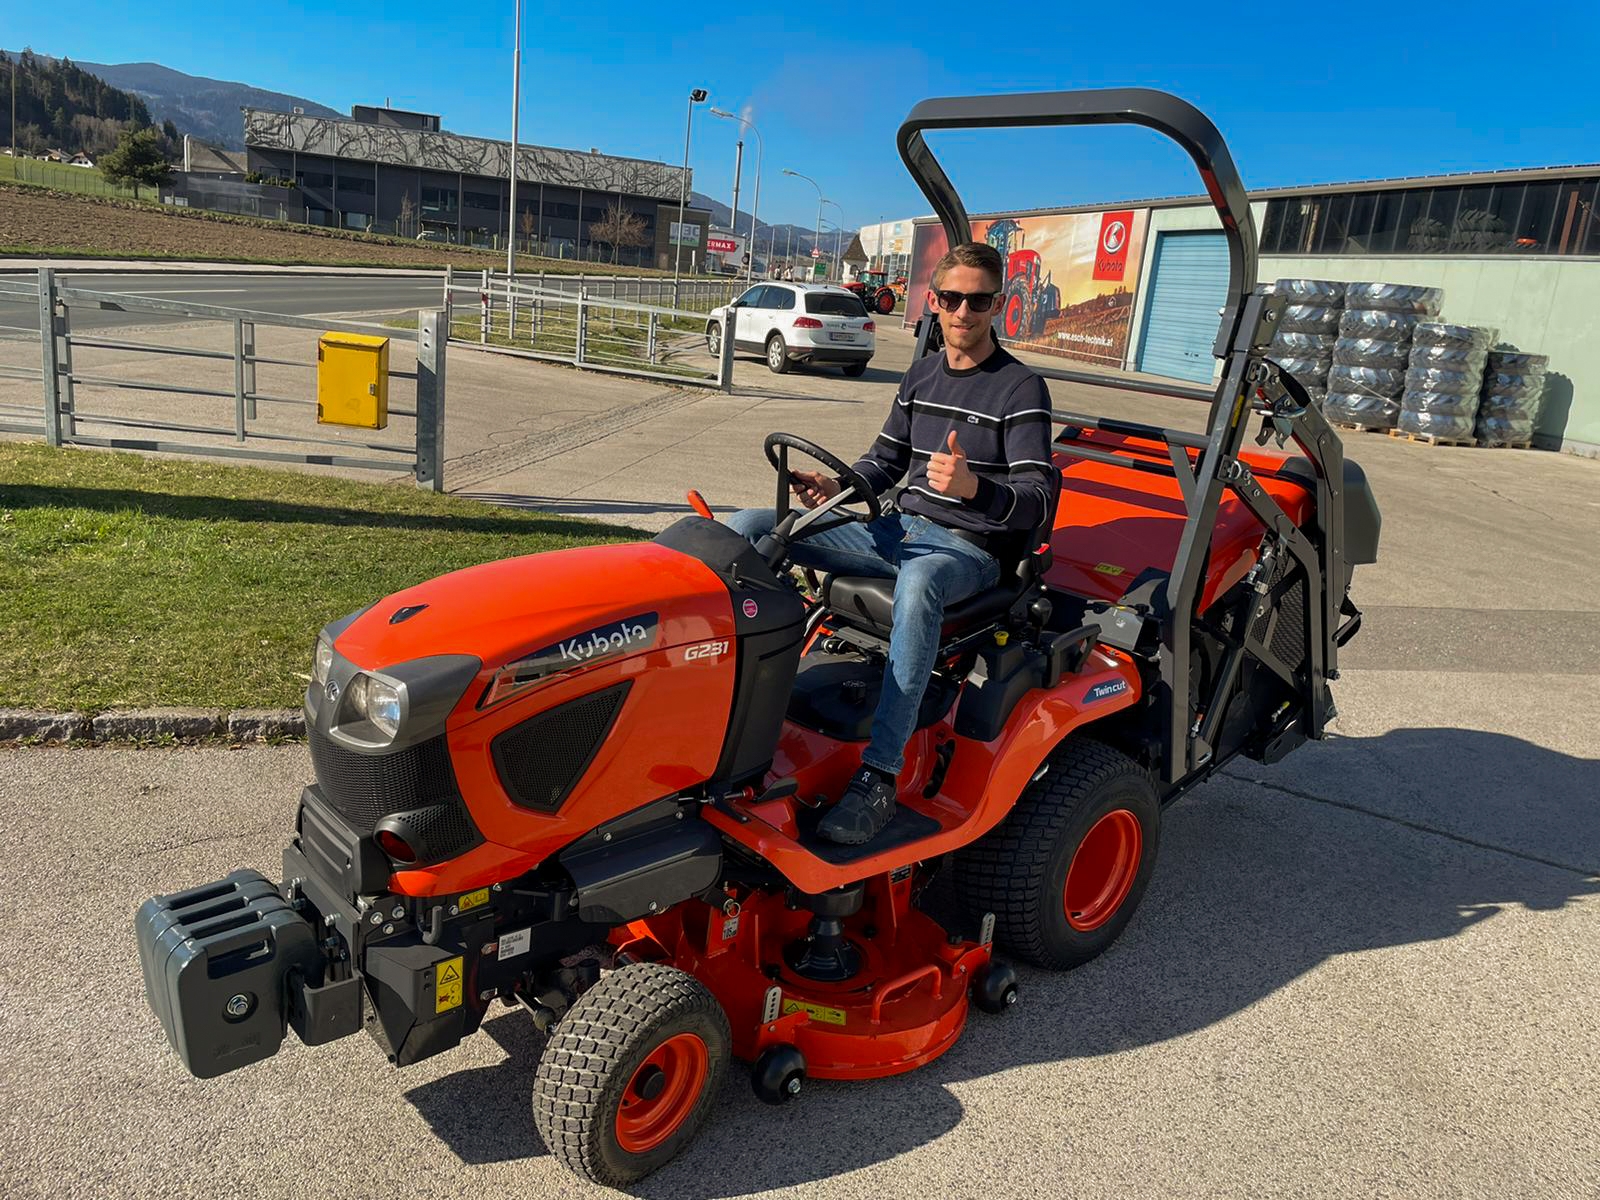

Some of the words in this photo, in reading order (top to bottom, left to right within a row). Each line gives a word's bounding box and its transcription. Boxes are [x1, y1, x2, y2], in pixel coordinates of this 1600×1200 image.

[1097, 258, 1123, 273] Kubota
[558, 623, 647, 661] Kubota
[684, 641, 729, 661] G231
